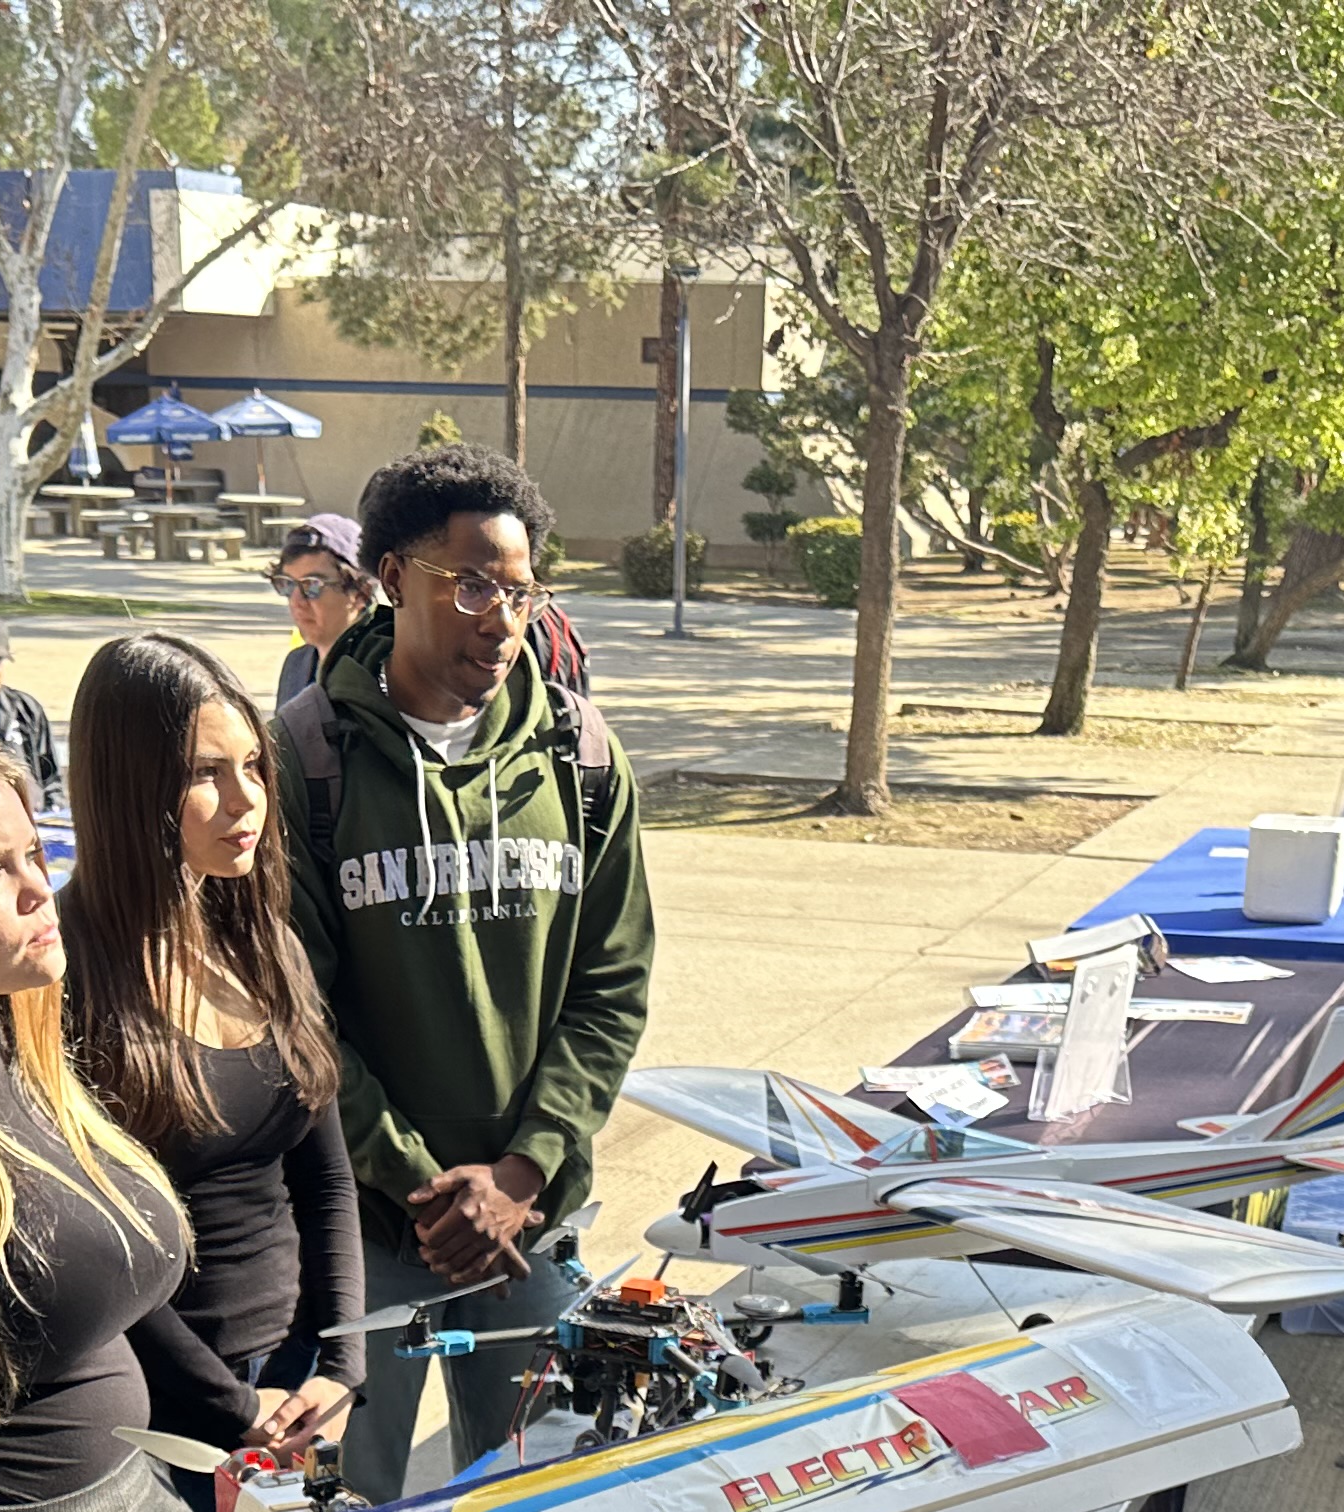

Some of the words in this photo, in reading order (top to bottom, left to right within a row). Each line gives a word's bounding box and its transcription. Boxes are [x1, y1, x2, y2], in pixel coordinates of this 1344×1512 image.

[339, 848, 410, 910] SAN
[414, 837, 583, 895] FRANCISCO
[400, 903, 538, 926] CALIFORNIA
